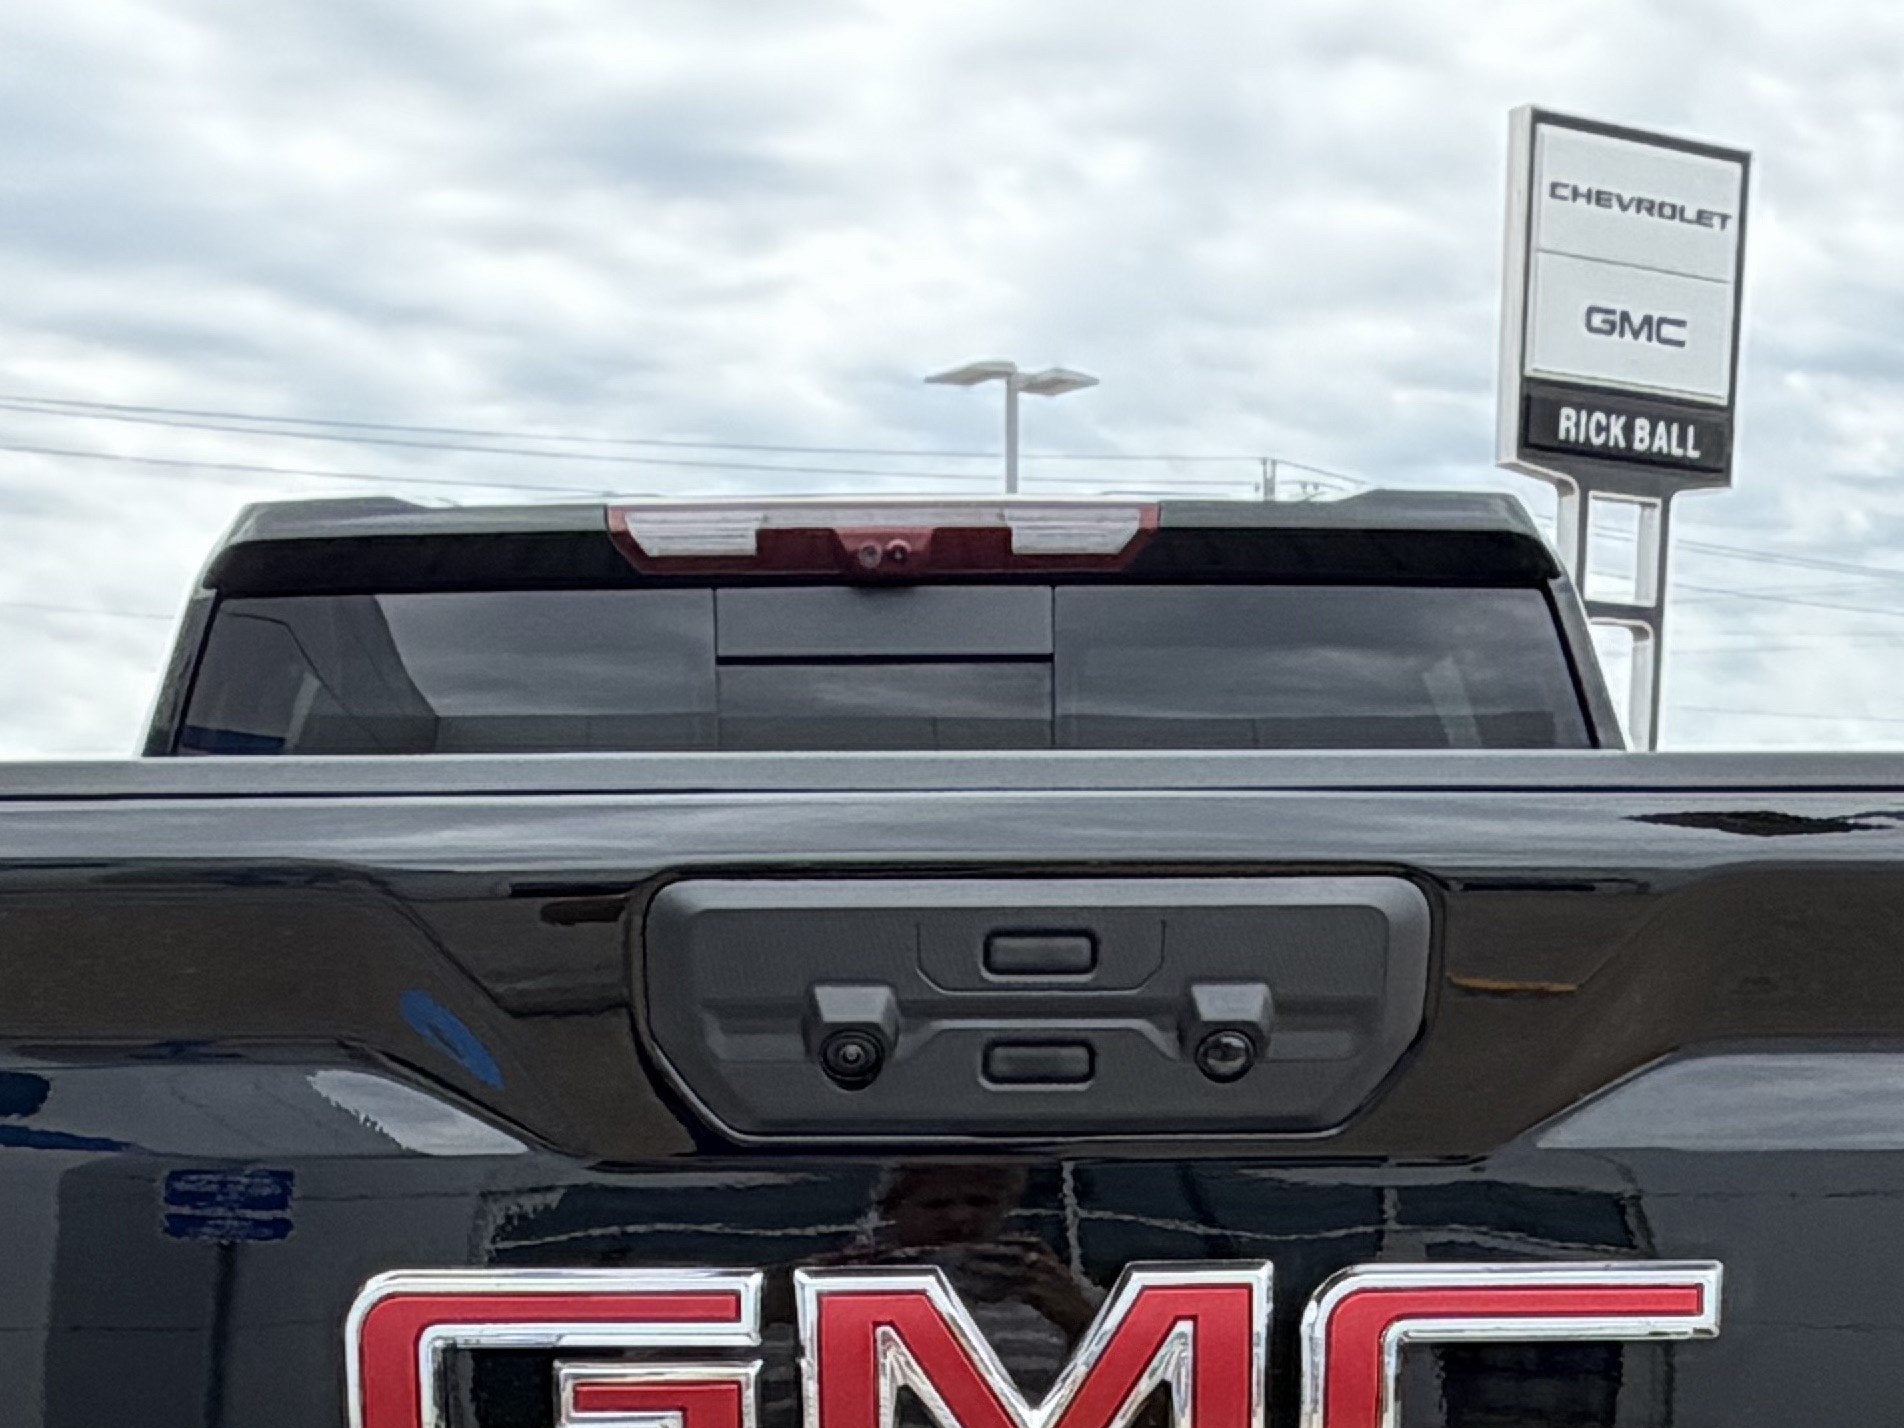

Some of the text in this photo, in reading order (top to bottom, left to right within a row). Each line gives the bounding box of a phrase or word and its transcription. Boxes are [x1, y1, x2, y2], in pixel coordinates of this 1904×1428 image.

[1548, 181, 1732, 231] CHEVROLET
[1584, 304, 1687, 348] GMC
[1558, 406, 1701, 458] RICK BALL
